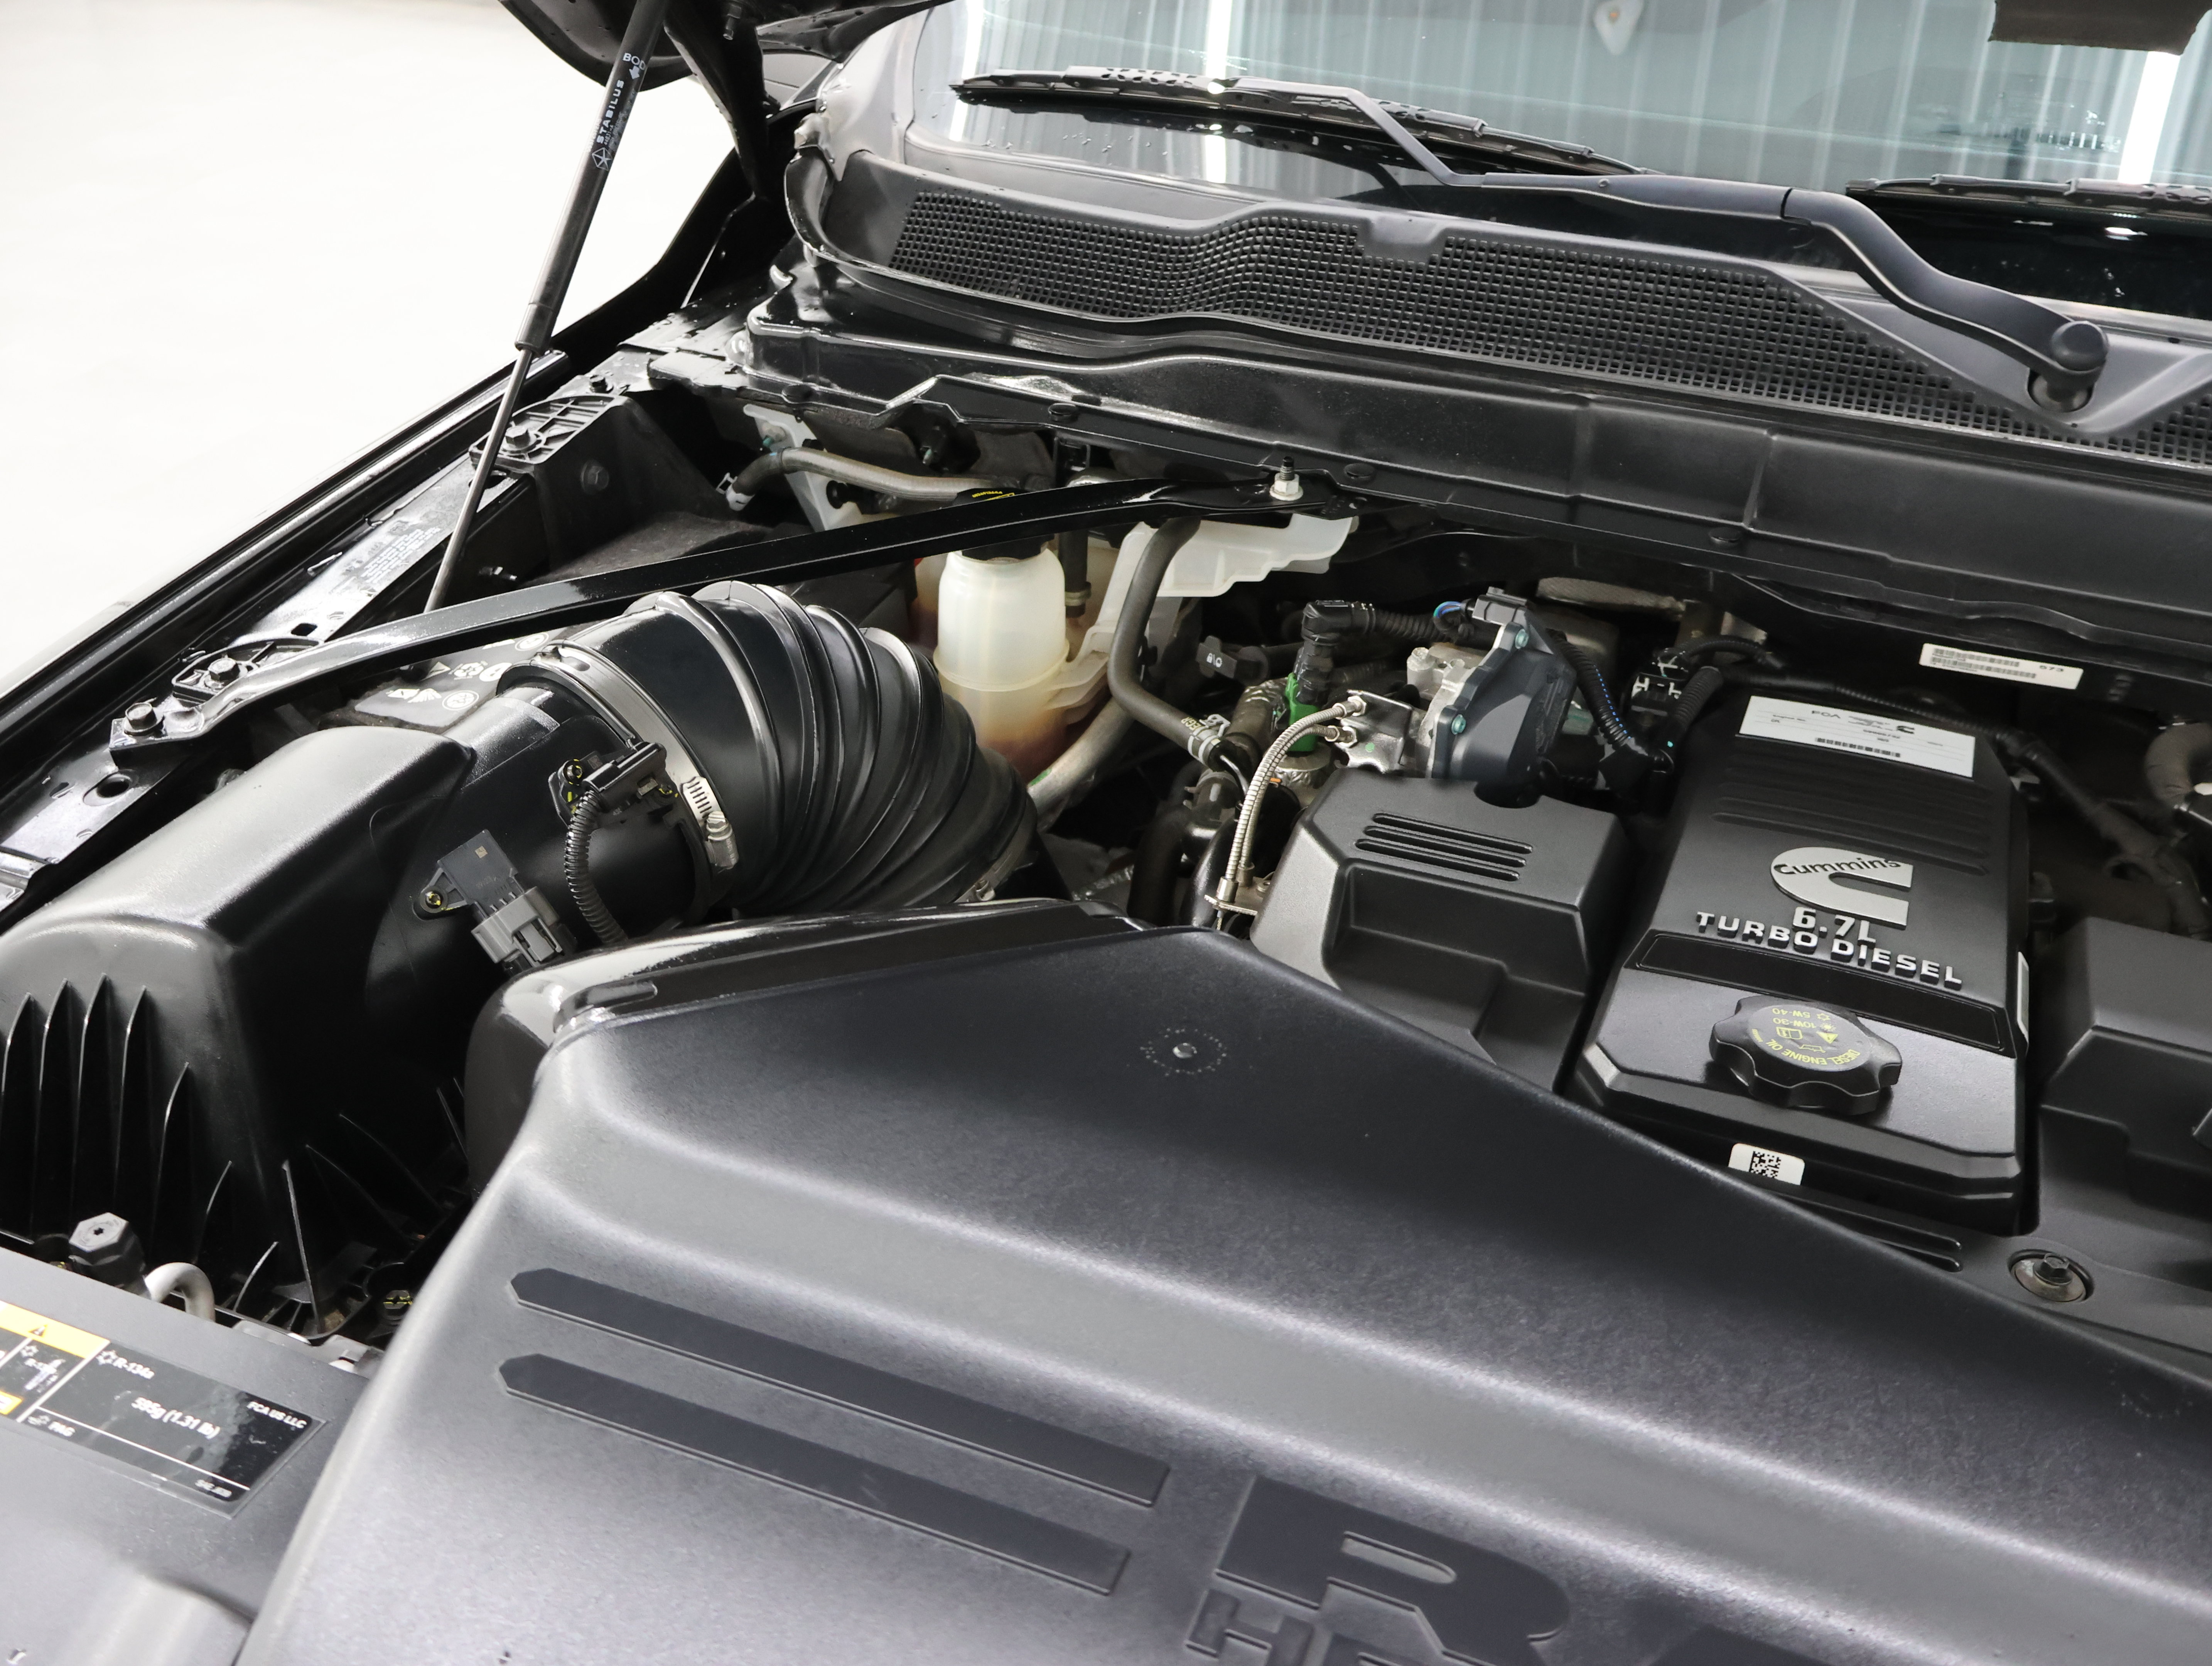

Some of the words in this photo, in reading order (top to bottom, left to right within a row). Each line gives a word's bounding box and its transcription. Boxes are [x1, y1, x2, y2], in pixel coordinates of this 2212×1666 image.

[597, 80, 624, 143] STABILUS
[1792, 906, 1876, 948] 6.7L
[1696, 911, 1819, 954] TURBO
[1831, 938, 1962, 991] DIESEL
[1772, 1008, 1810, 1018] 5W-40
[1773, 1017, 1817, 1029] 10W-30
[1765, 1039, 1783, 1051] OIL
[1781, 1049, 1827, 1065] ENGINE
[1829, 1049, 1861, 1065] DIESEL
[113, 1357, 155, 1379] R-134a
[246, 1401, 270, 1415] FCA
[268, 1409, 286, 1421] US
[284, 1415, 307, 1429] LLC
